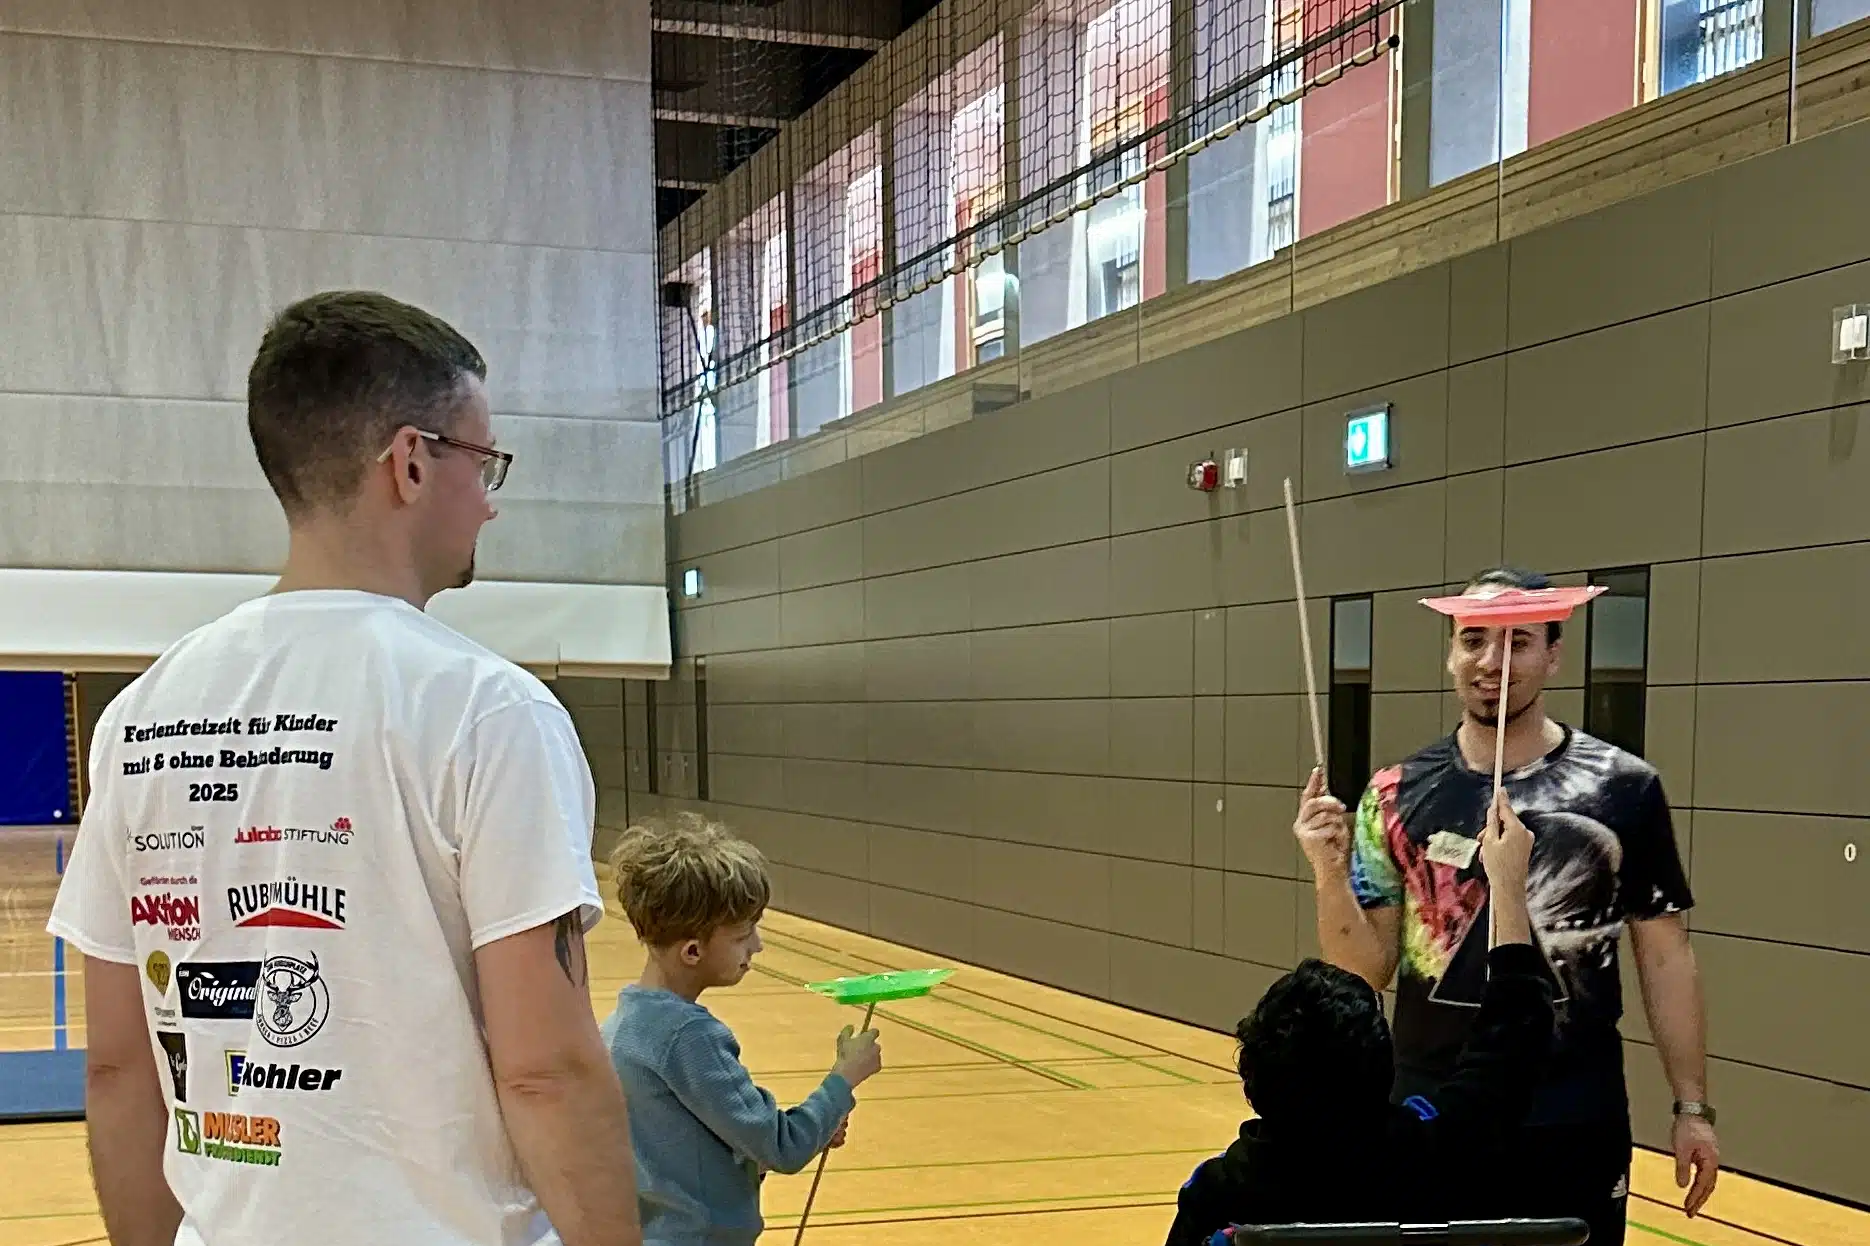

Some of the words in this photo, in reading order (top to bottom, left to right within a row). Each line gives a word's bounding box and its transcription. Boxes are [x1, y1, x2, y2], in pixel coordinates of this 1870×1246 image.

[124, 717, 242, 743] Ferienfreizeit
[274, 713, 338, 733] Kinder
[153, 753, 164, 771] &
[169, 751, 214, 769] ohne
[189, 783, 239, 802] 2025
[134, 831, 205, 852] SOLUTION
[283, 828, 349, 845] STIFTUNG
[188, 971, 257, 1006] Origina
